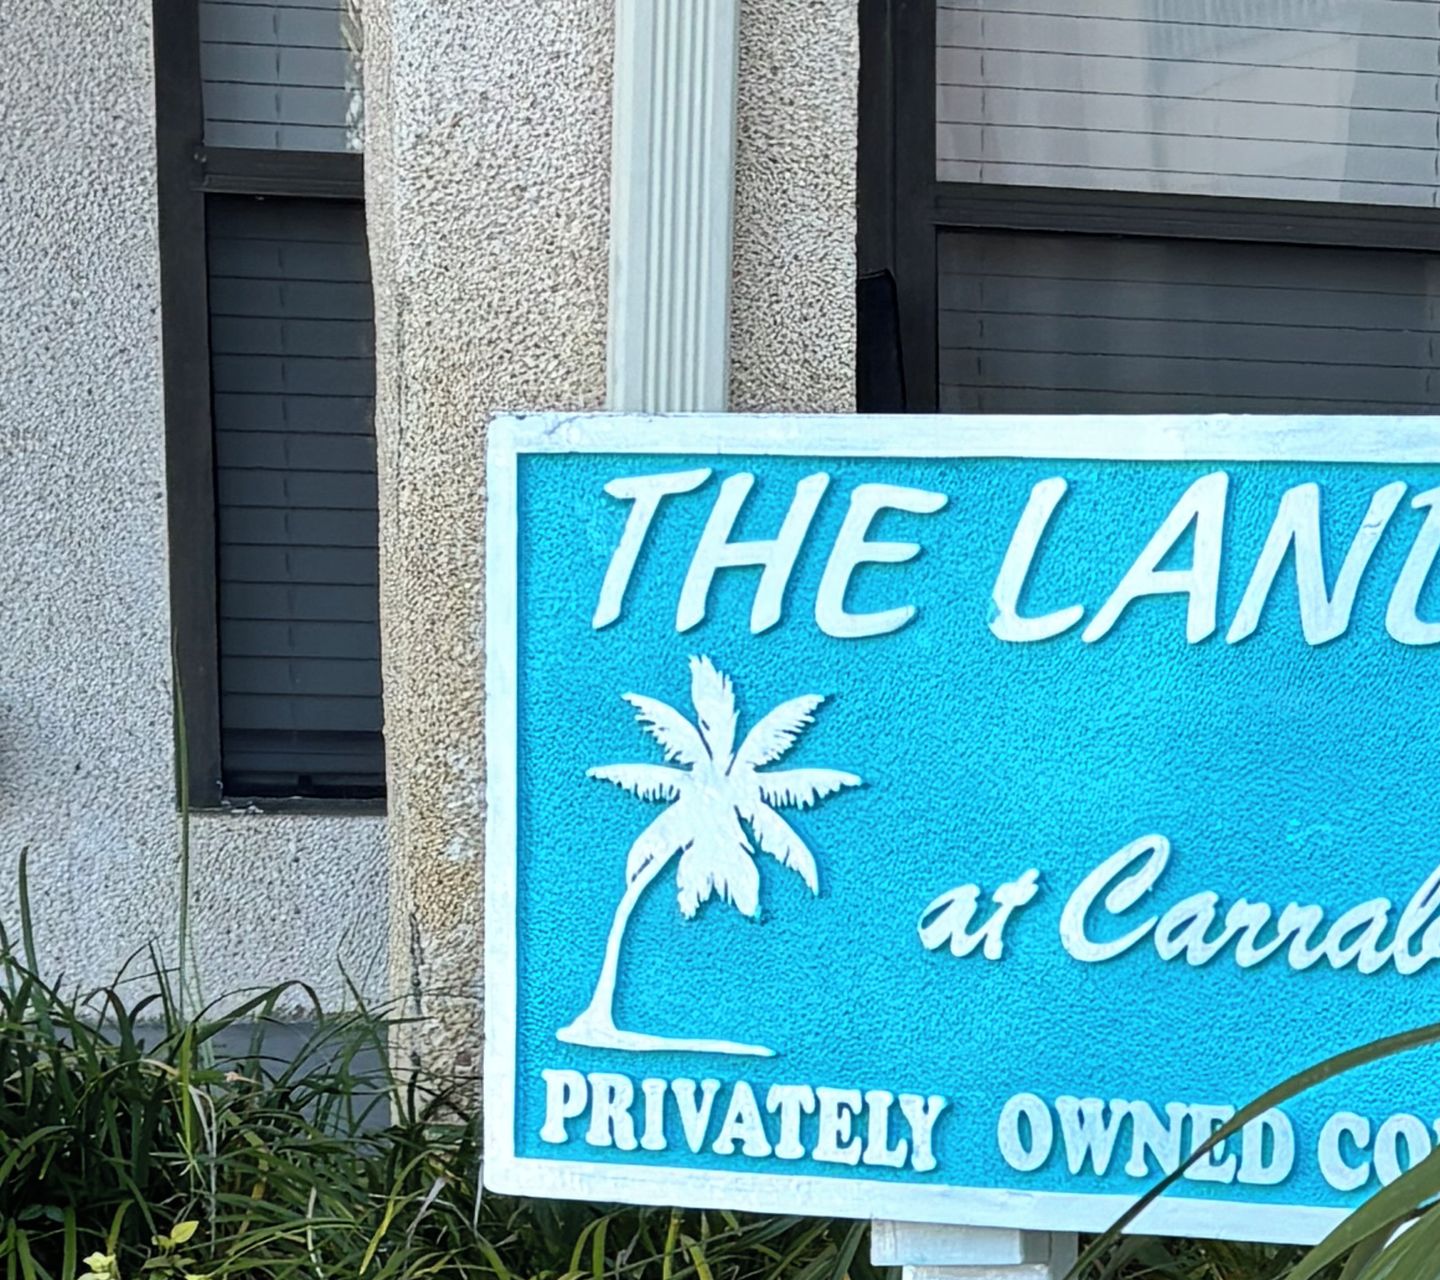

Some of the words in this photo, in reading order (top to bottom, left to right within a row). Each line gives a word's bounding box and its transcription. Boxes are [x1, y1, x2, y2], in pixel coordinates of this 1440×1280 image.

[591, 467, 949, 639] THE
[916, 868, 1041, 962] at
[540, 1068, 950, 1172] PRIVATELY
[996, 1092, 1296, 1185] OWNED
